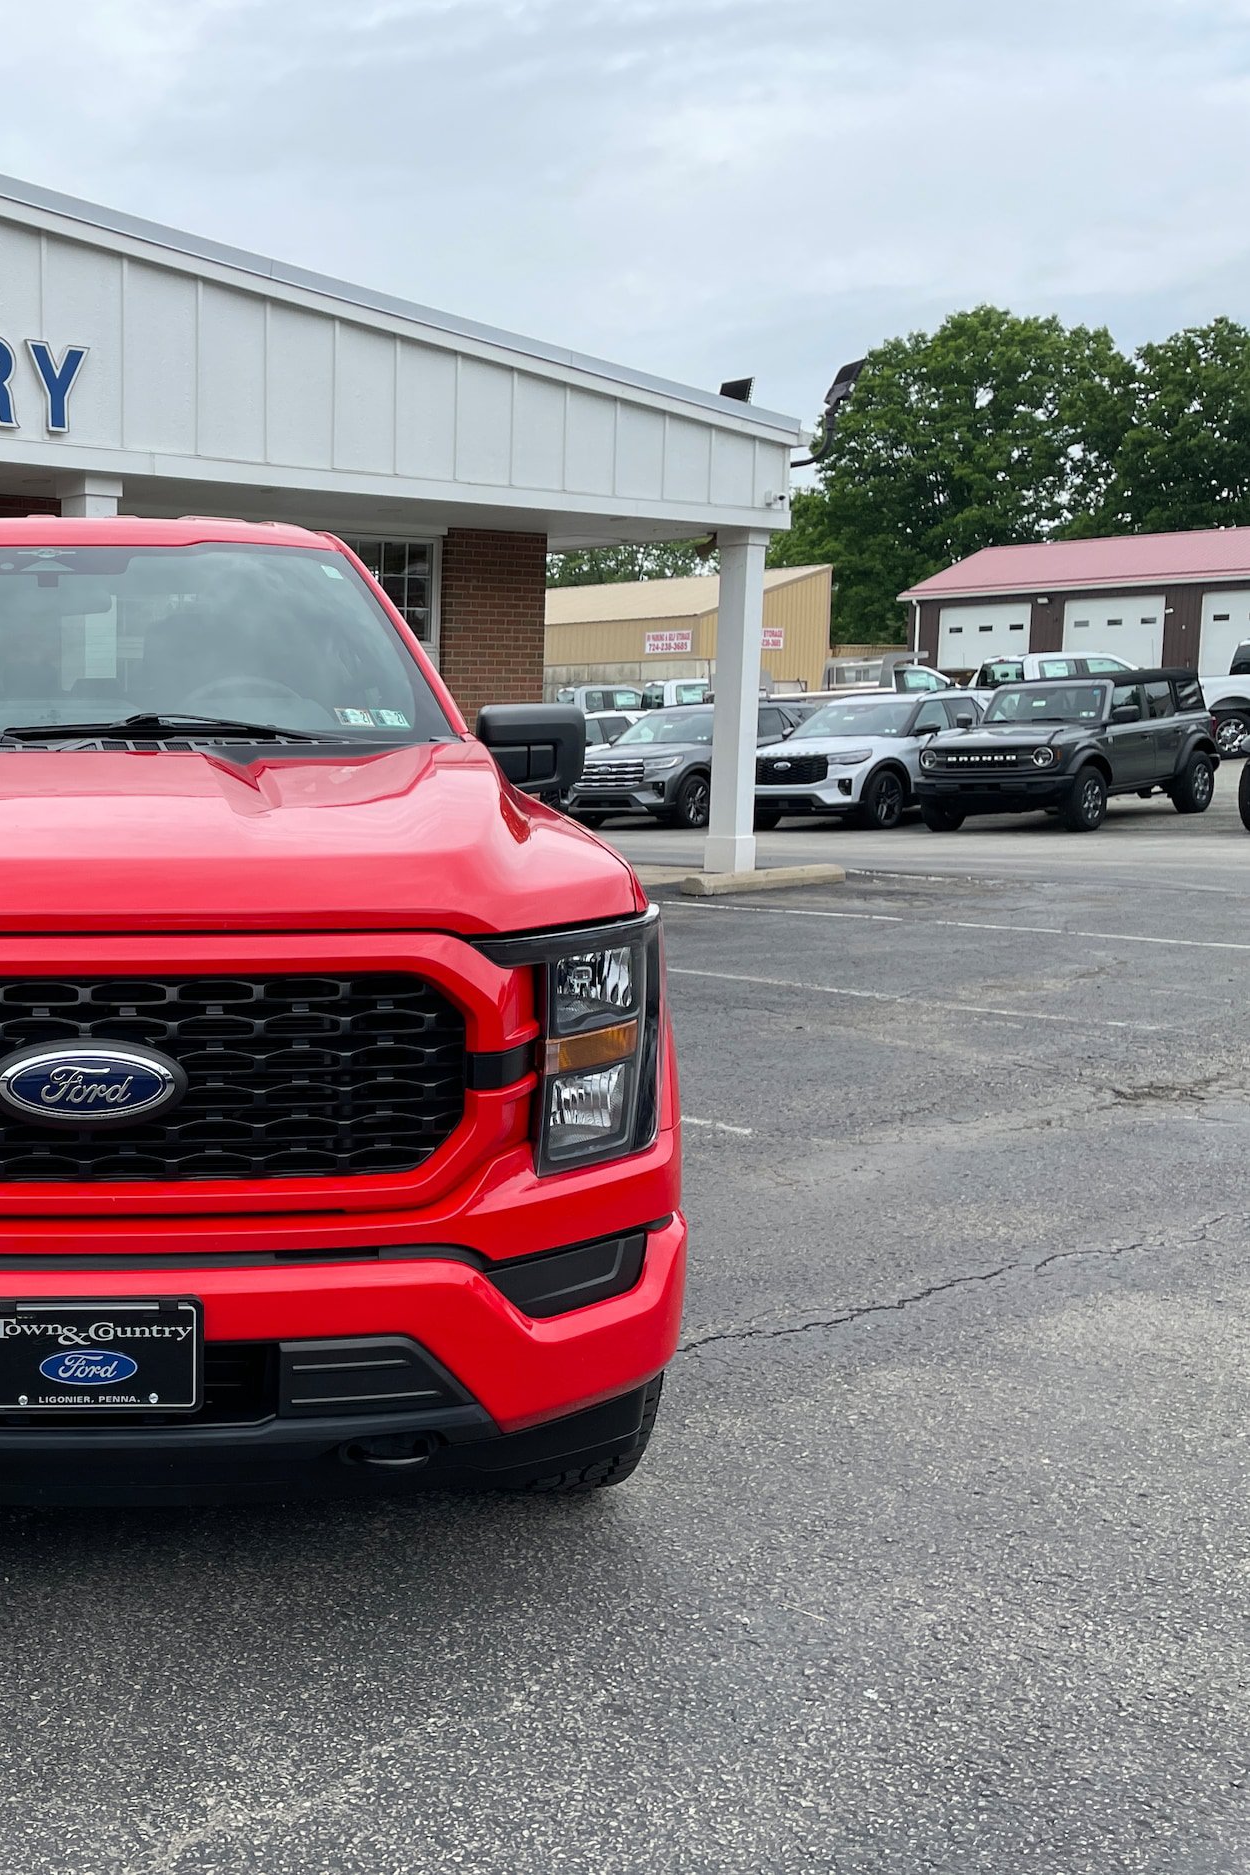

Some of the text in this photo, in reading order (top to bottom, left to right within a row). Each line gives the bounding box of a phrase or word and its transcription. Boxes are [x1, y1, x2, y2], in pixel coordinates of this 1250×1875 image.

[947, 754, 1017, 762] BRONCO
[41, 1065, 134, 1103] Ford
[88, 1322, 193, 1341] Country
[58, 1354, 119, 1379] Ford
[38, 1395, 141, 1404] LIGONIER, PENNA.
